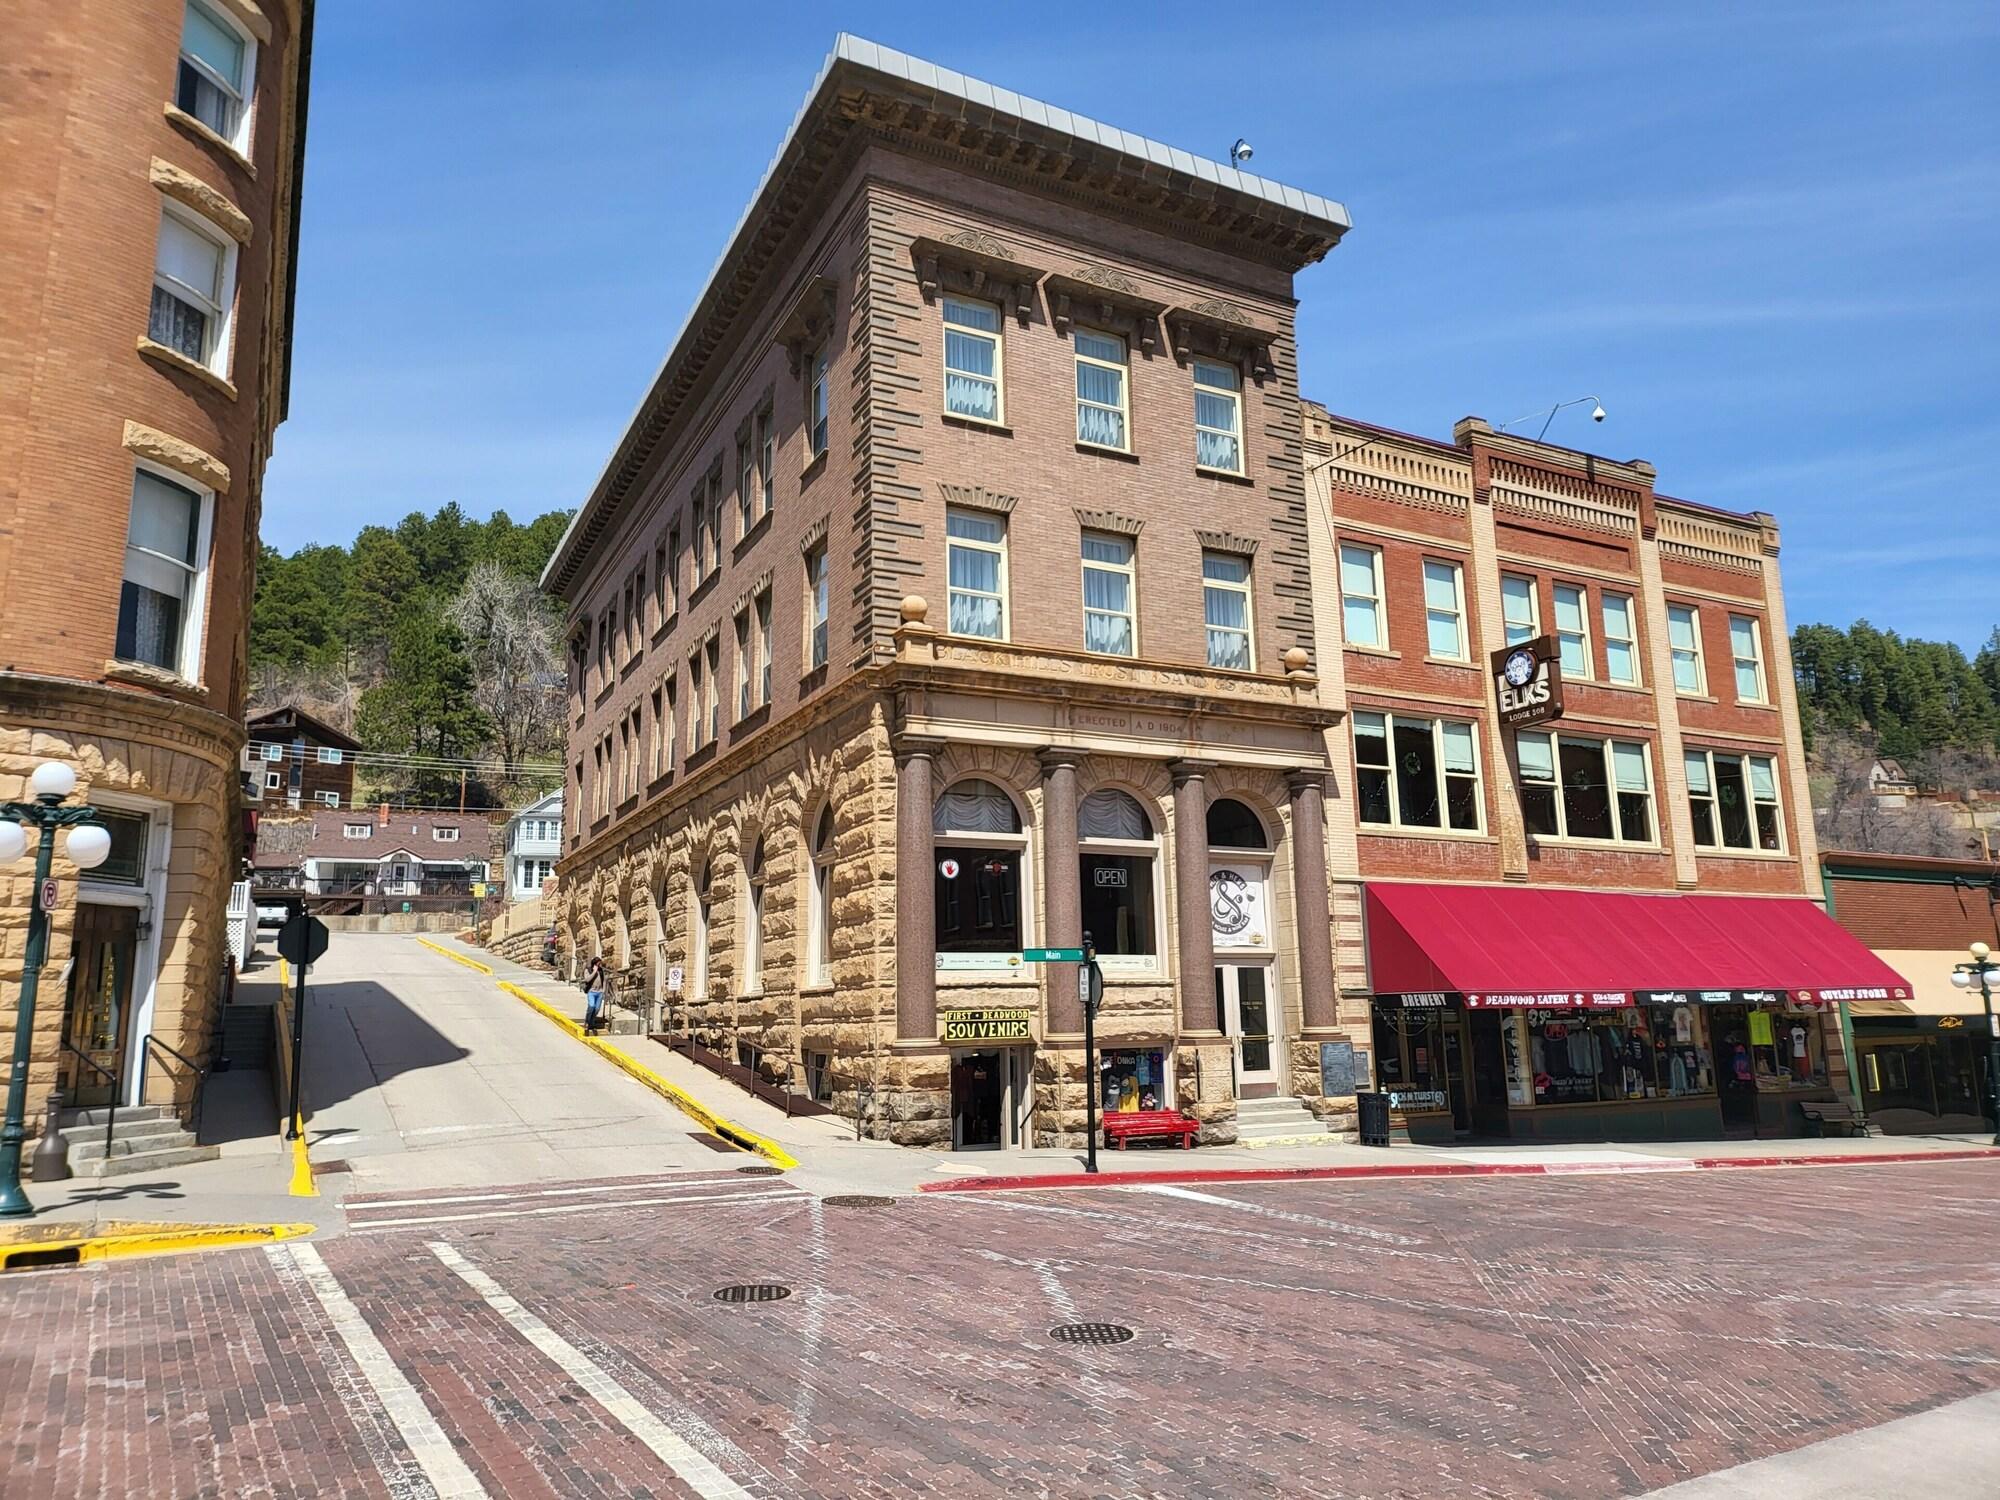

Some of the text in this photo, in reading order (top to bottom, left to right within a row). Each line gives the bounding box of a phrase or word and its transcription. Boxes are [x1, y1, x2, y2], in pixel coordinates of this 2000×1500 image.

[935, 645, 1008, 667] BLACK
[1500, 681, 1550, 712] ELKS
[1509, 711, 1531, 721] LODGE
[1078, 715, 1126, 728] ERECTED
[1136, 721, 1143, 730] A
[1148, 722, 1154, 731] D
[1097, 870, 1125, 884] OPEN
[1045, 951, 1061, 960] Main
[1401, 994, 1446, 1007] BREWERY
[1486, 994, 1569, 1005] DEADWOOD EATERY
[1820, 988, 1888, 1000] OUTLET STORE
[948, 1011, 1028, 1020] FIRST DEADWOOD
[948, 1022, 1027, 1038] SOUVENIRS
